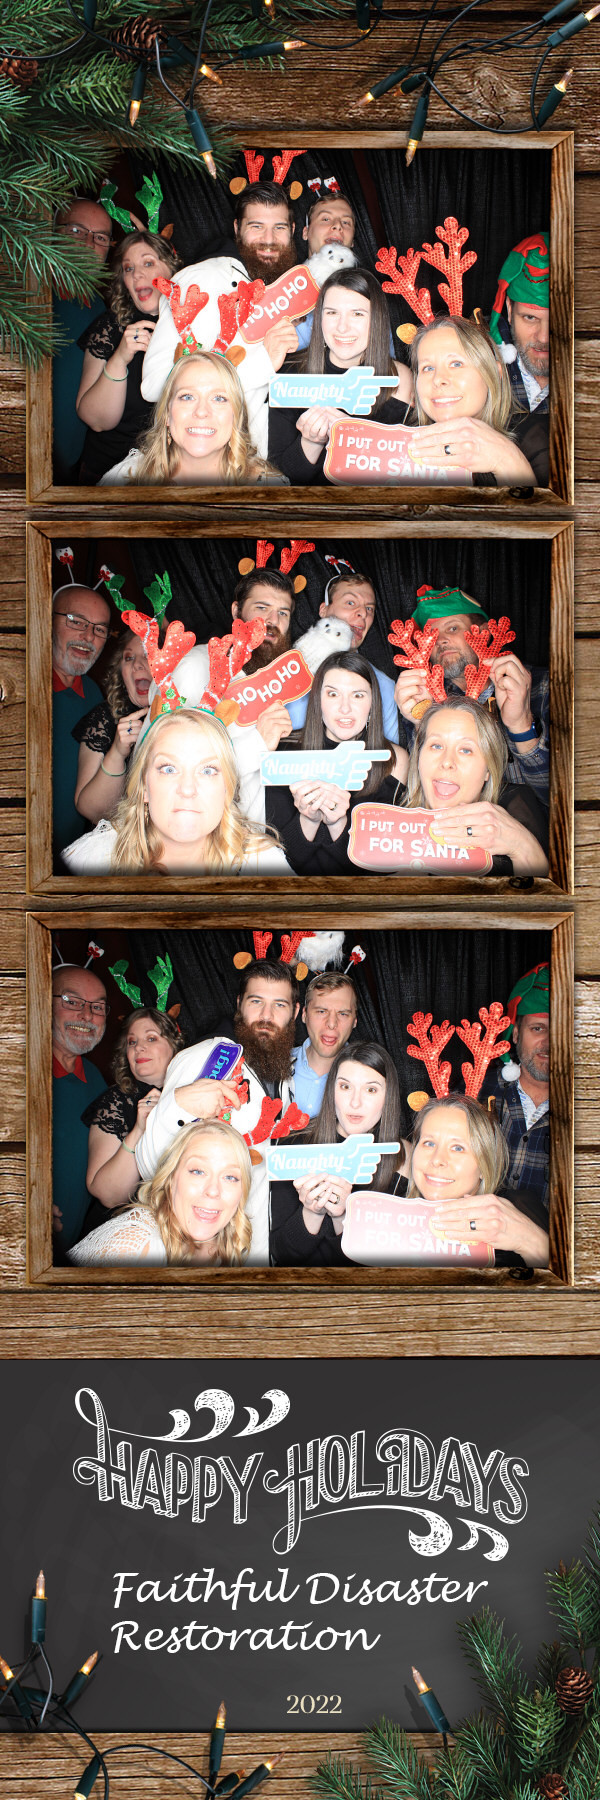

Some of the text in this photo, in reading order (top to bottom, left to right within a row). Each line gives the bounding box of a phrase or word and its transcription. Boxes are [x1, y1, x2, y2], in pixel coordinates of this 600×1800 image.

[273, 381, 351, 403] Naughty
[338, 433, 406, 453] I PUT OUT
[345, 453, 449, 482] FOR SANTA
[264, 758, 343, 779] Naughty
[360, 818, 427, 834] I PUT OUT
[369, 837, 470, 860] FOR SANTA
[271, 1153, 352, 1173] Naughty
[356, 1208, 427, 1227] I PUT OUT
[365, 1229, 472, 1257] FOR SANTA
